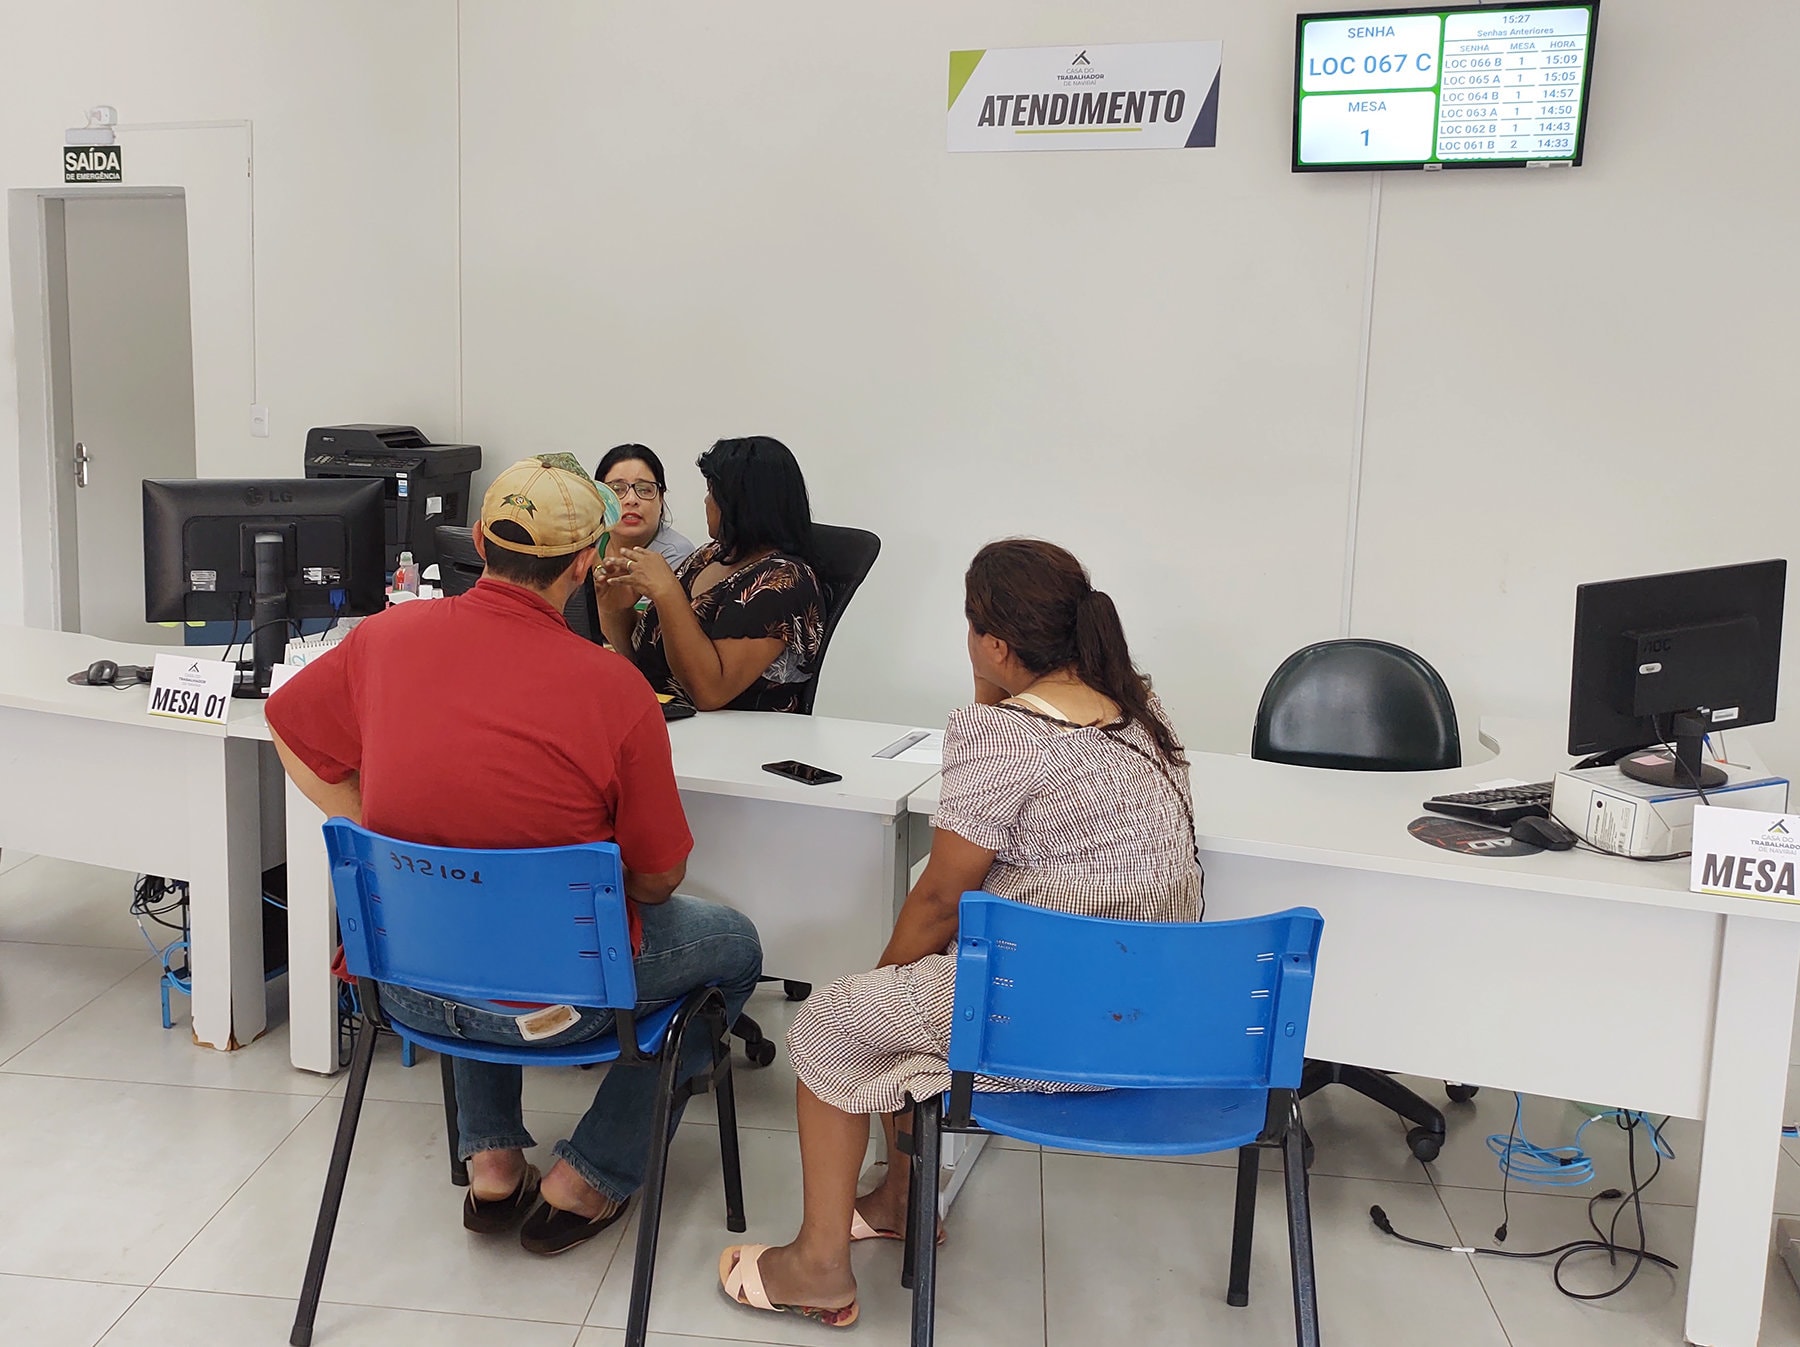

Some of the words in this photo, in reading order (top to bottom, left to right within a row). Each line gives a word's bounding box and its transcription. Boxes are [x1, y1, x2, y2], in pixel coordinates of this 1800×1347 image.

[1503, 14, 1531, 24] 15:27
[1347, 26, 1395, 38] SENHA
[1477, 29, 1508, 37] Senhas
[1509, 27, 1554, 36] Anteriores
[1460, 44, 1490, 53] SENHA
[1510, 42, 1536, 50] MESA
[1549, 40, 1576, 48] HORA
[1309, 56, 1356, 76] LOC
[1363, 54, 1408, 74] 067
[1415, 53, 1432, 71] C
[1445, 59, 1467, 69] LOC
[1470, 58, 1491, 68] 066
[1494, 57, 1502, 67] B
[1519, 56, 1524, 66] 1
[1546, 54, 1578, 64] 15:09
[1443, 76, 1465, 86] LOC
[1468, 75, 1489, 85] 065
[1492, 74, 1501, 83] A
[1517, 73, 1523, 82] 1
[1544, 71, 1576, 81] 15:05
[1442, 92, 1464, 102] LOC
[1467, 92, 1488, 101] 064
[1491, 91, 1499, 100] B
[1516, 90, 1521, 99] 1
[1543, 88, 1574, 98] 14:57
[977, 89, 1186, 127] ATENDIMENTO
[1348, 101, 1387, 112] MESA
[1441, 109, 1463, 118] LOC
[1466, 108, 1487, 117] 063
[1489, 107, 1498, 117] A
[1514, 107, 1519, 116] 1
[1541, 105, 1573, 115] 14:50
[1440, 125, 1462, 134] LOC
[1465, 125, 1485, 134] 062
[1488, 124, 1496, 133] B
[1513, 123, 1518, 132] 1
[1539, 122, 1570, 131] 14:43
[1360, 129, 1369, 146] 1
[1439, 141, 1461, 150] LOC
[1464, 141, 1483, 150] 061
[1487, 140, 1495, 149] B
[1510, 140, 1517, 149] 2
[1537, 138, 1569, 148] 14:33
[65, 147, 120, 171] SAÍDA
[76, 172, 120, 180] EMERGÊNCIA
[270, 492, 293, 503] LG
[151, 687, 200, 716] MESA
[204, 694, 227, 719] 01
[1761, 834, 1780, 842] CASA
[1701, 853, 1795, 896] MESA
